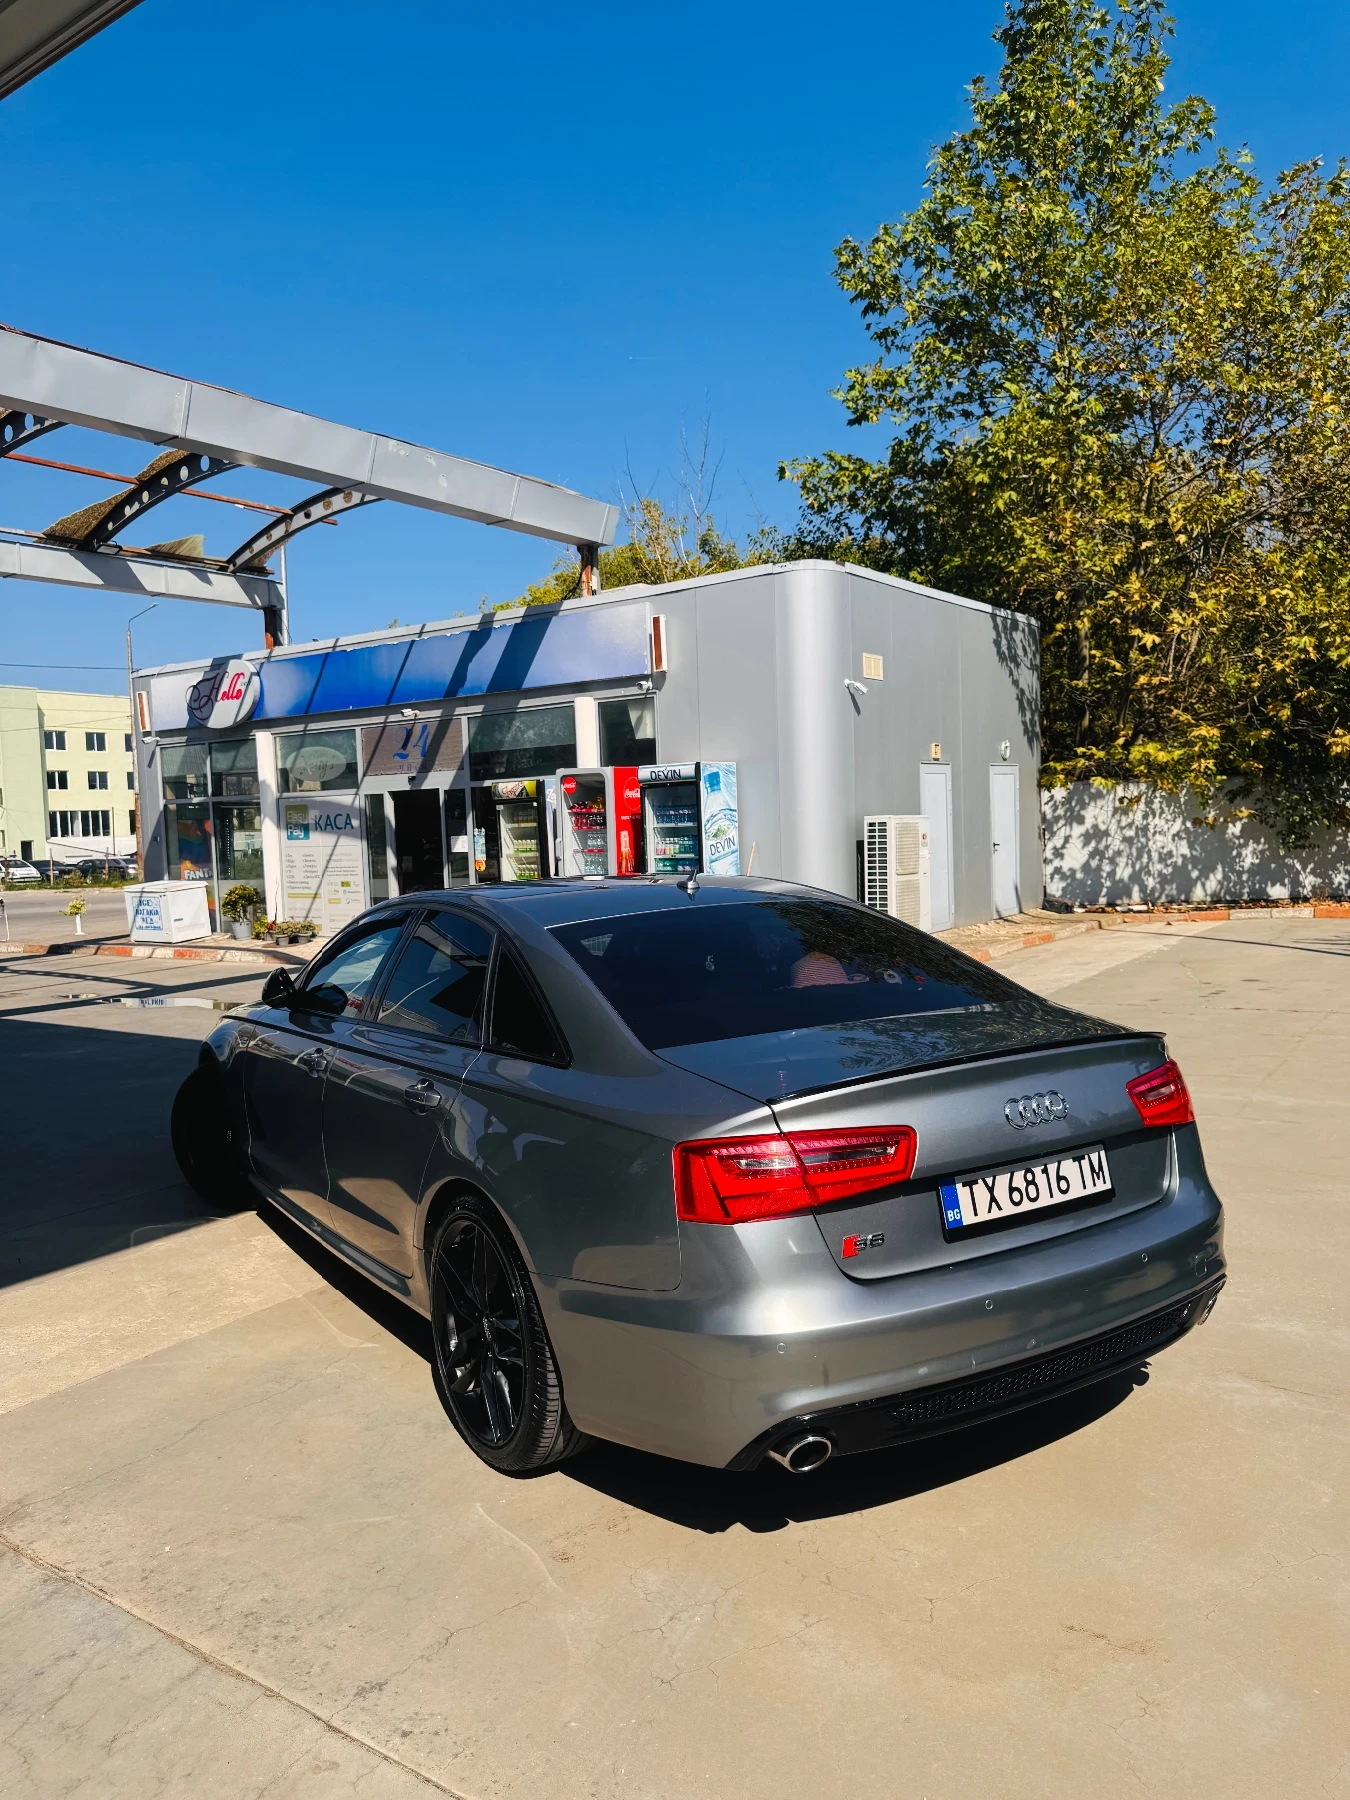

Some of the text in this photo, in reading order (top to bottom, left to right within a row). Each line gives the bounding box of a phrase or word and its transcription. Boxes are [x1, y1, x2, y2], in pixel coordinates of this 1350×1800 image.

[185, 671, 245, 720] Hello
[393, 724, 430, 760] 24
[650, 768, 682, 780] DEVIN
[287, 811, 308, 824] Easy
[314, 812, 354, 831] КАСА
[287, 824, 305, 838] Pay
[709, 835, 736, 856] DEVIN
[962, 1151, 1107, 1217] TX 6816 TM
[947, 1209, 961, 1222] BG
